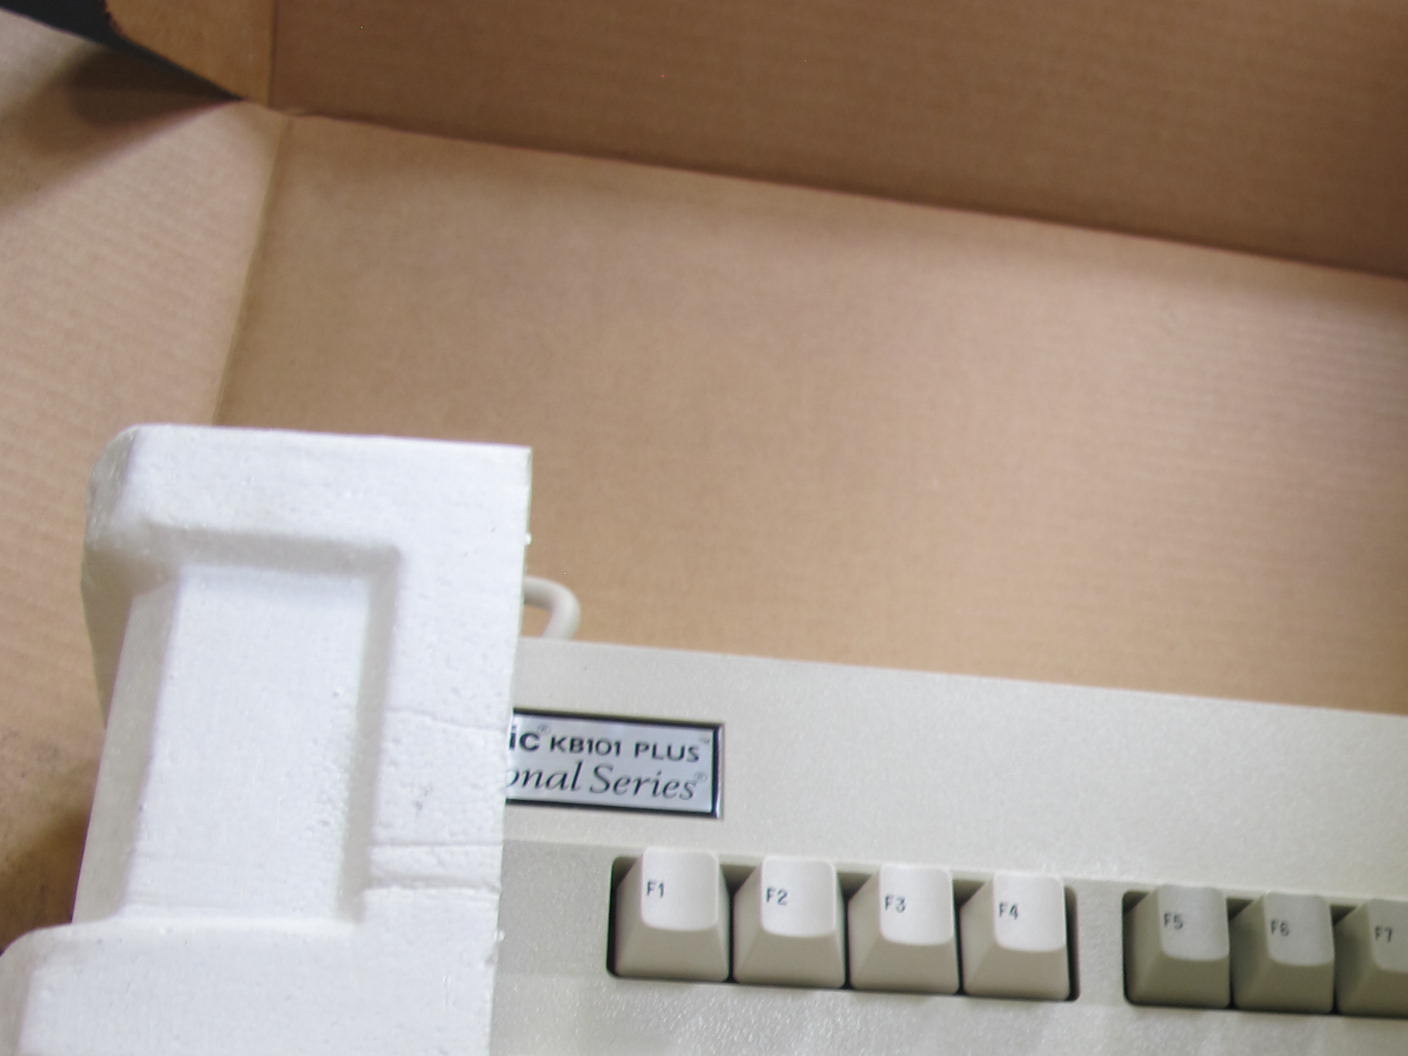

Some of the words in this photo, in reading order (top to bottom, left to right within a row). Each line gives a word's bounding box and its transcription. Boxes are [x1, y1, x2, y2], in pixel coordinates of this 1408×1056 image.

[550, 736, 621, 757] KB101
[634, 742, 700, 763] PLUS
[589, 764, 697, 800] Series
[645, 880, 667, 898] F1
[765, 887, 789, 906] F2
[884, 896, 908, 914] F3
[998, 902, 1020, 921] F4
[1163, 912, 1184, 930] F5
[1269, 919, 1290, 937] F6
[1374, 926, 1395, 943] F7
